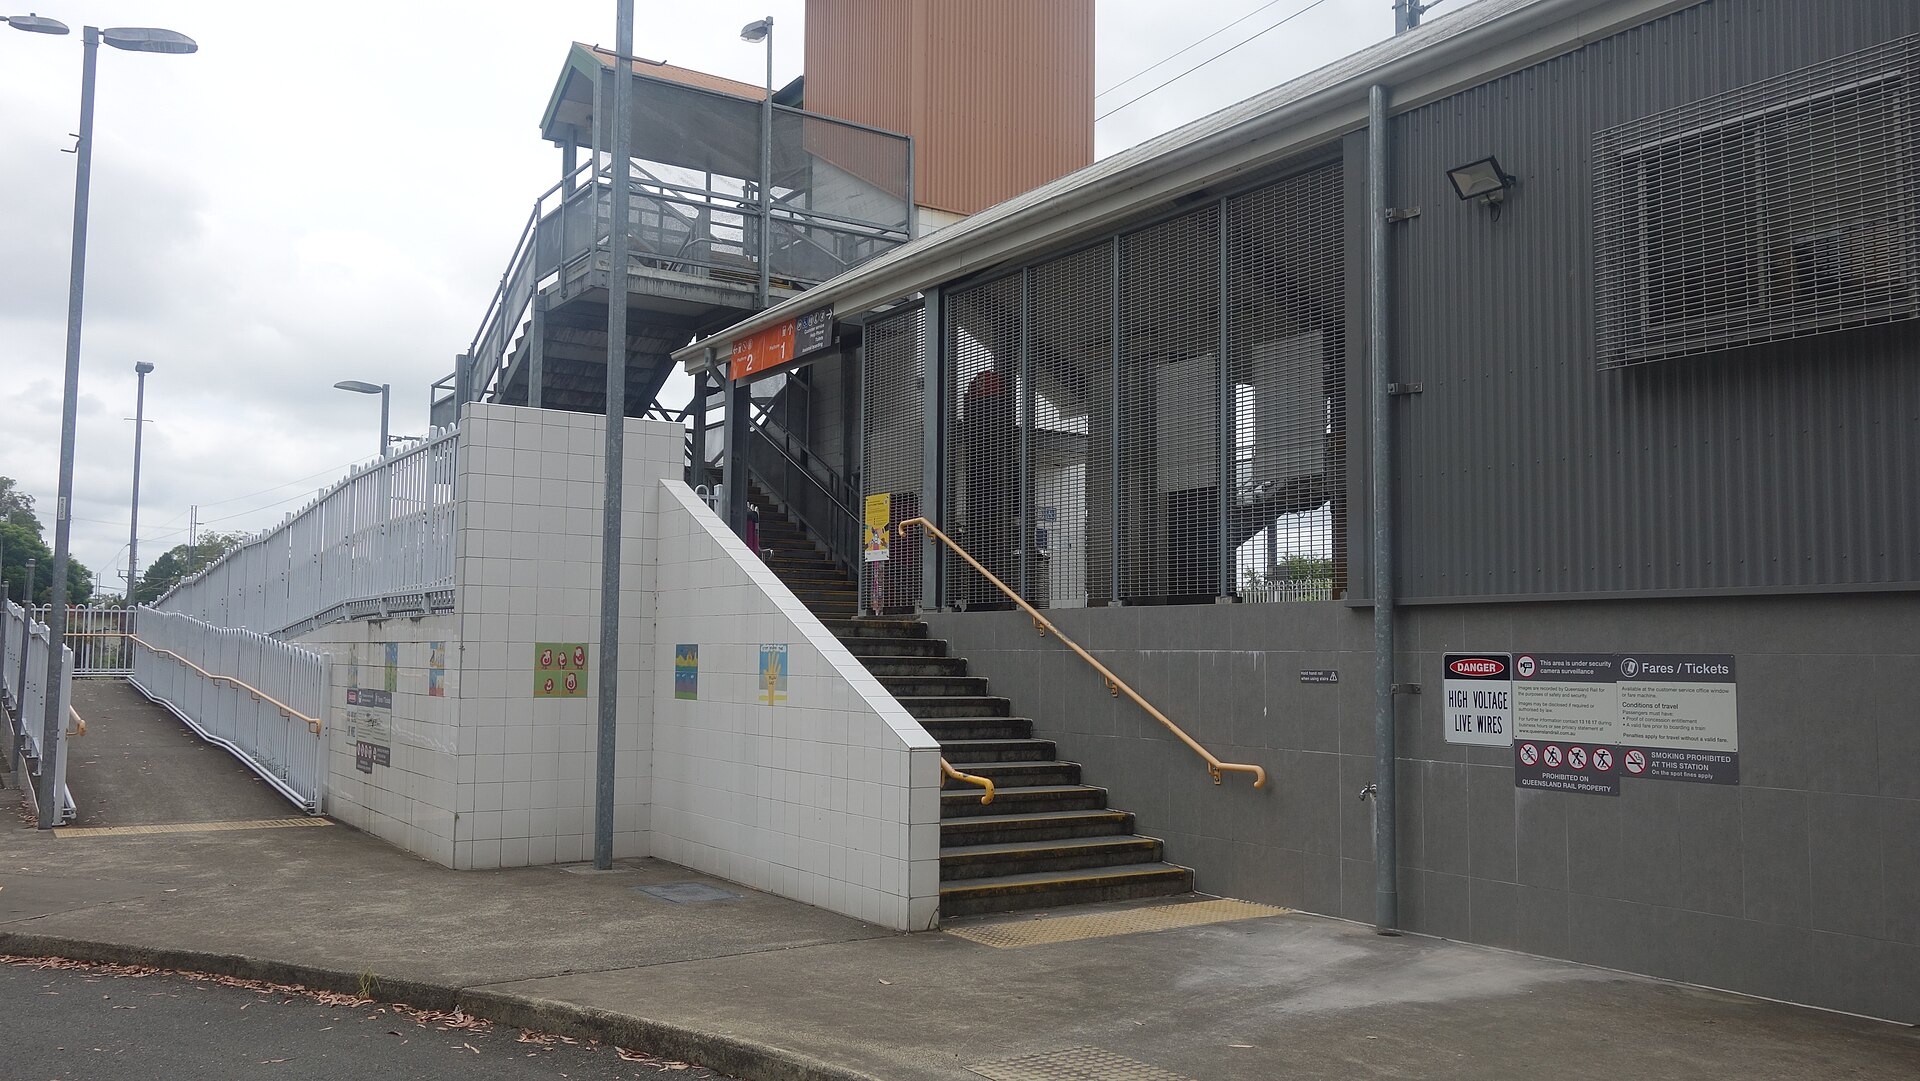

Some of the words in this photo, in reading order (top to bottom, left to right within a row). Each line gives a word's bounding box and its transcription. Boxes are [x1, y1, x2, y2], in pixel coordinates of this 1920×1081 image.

[780, 342, 785, 359] 1
[746, 354, 753, 372] 2
[1457, 663, 1496, 672] DANGER
[1642, 662, 1674, 673] Fares
[1677, 663, 1682, 673] /
[1685, 663, 1729, 674] Tickets
[1448, 690, 1468, 708] HIGH
[1473, 690, 1508, 710] VOLTAGE
[1455, 714, 1472, 732] LIVE
[1477, 715, 1502, 734] WIRES
[1651, 752, 1684, 760] SMOKING
[1686, 754, 1731, 763] PROHIBITED
[1542, 772, 1578, 781] PROHIBITED
[1522, 779, 1562, 788] QUEENSLAND
[1578, 784, 1611, 792] PROPERTY
